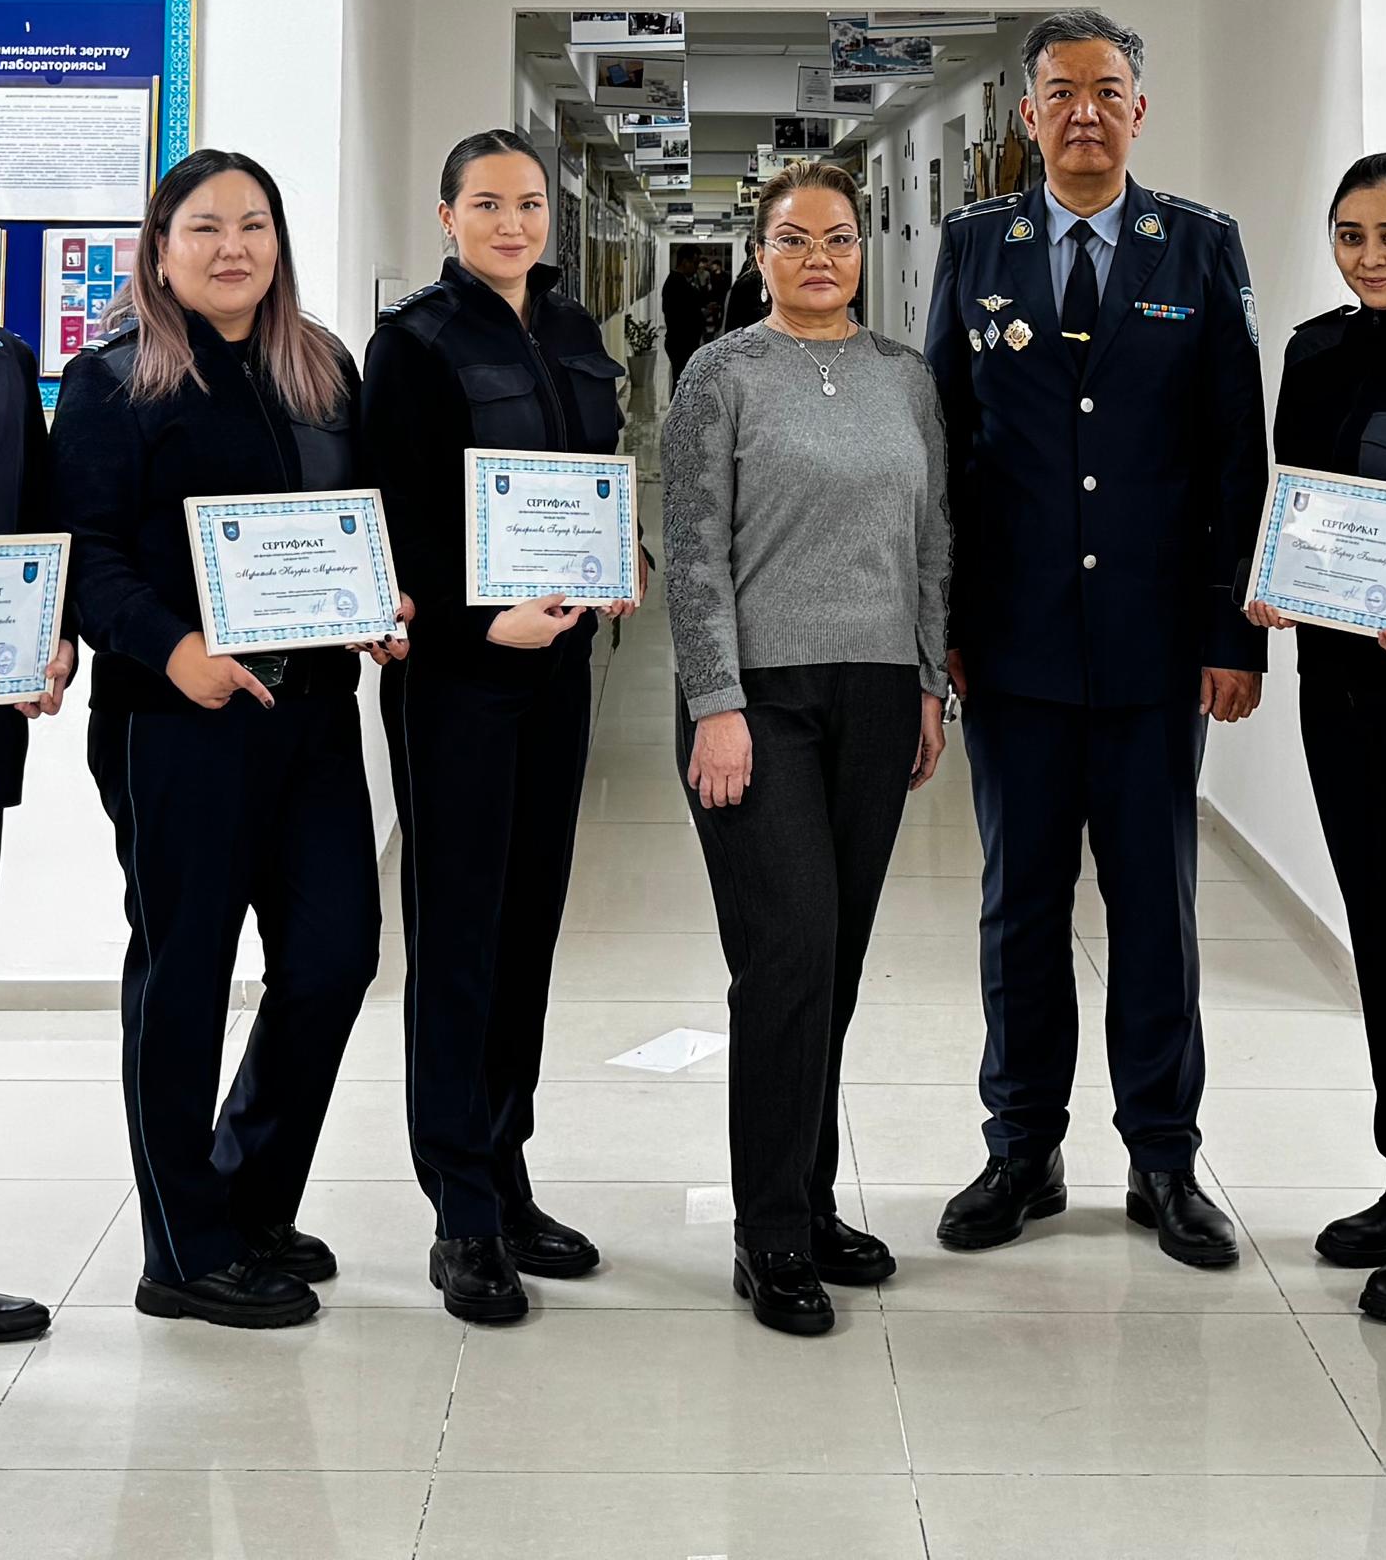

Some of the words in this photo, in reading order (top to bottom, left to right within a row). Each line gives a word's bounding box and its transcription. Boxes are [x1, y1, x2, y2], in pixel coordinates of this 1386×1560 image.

[79, 46, 130, 58] зерттеу
[0, 58, 106, 72] лабораториясы
[1322, 518, 1379, 536] СЕРТИФИКАТ
[262, 538, 325, 550] СЕРТИФИКАТ
